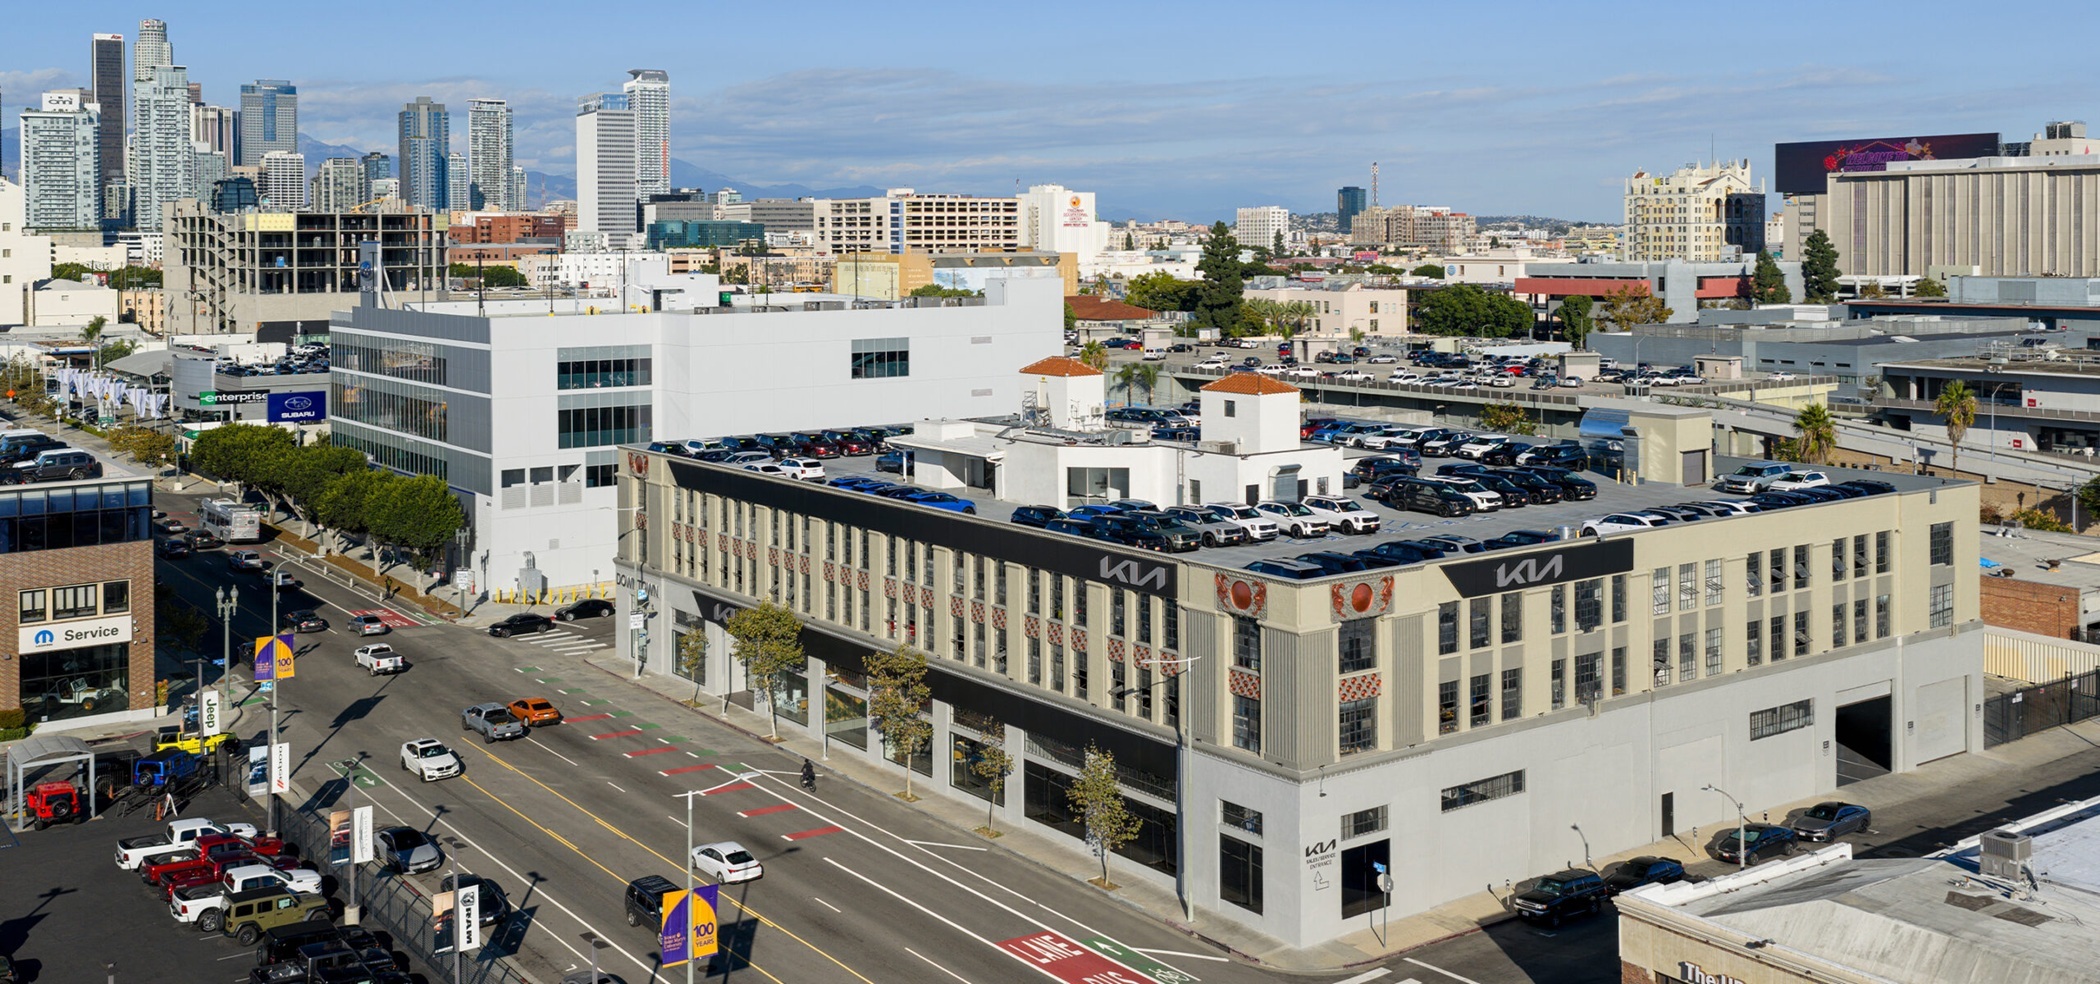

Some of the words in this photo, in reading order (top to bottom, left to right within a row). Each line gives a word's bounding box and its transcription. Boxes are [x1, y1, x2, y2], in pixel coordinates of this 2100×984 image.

[1845, 152, 1893, 165] WELCOME
[1100, 555, 1166, 591] KIA
[1496, 554, 1563, 588] KIA
[64, 626, 119, 642] Service
[278, 657, 293, 667] 100
[205, 699, 217, 728] Jeep
[1305, 839, 1336, 857] KIA
[465, 907, 473, 944] RAM
[693, 922, 714, 937] 100
[696, 939, 714, 947] YEARS
[1007, 935, 1084, 964] LANE
[1684, 961, 1716, 984] The
